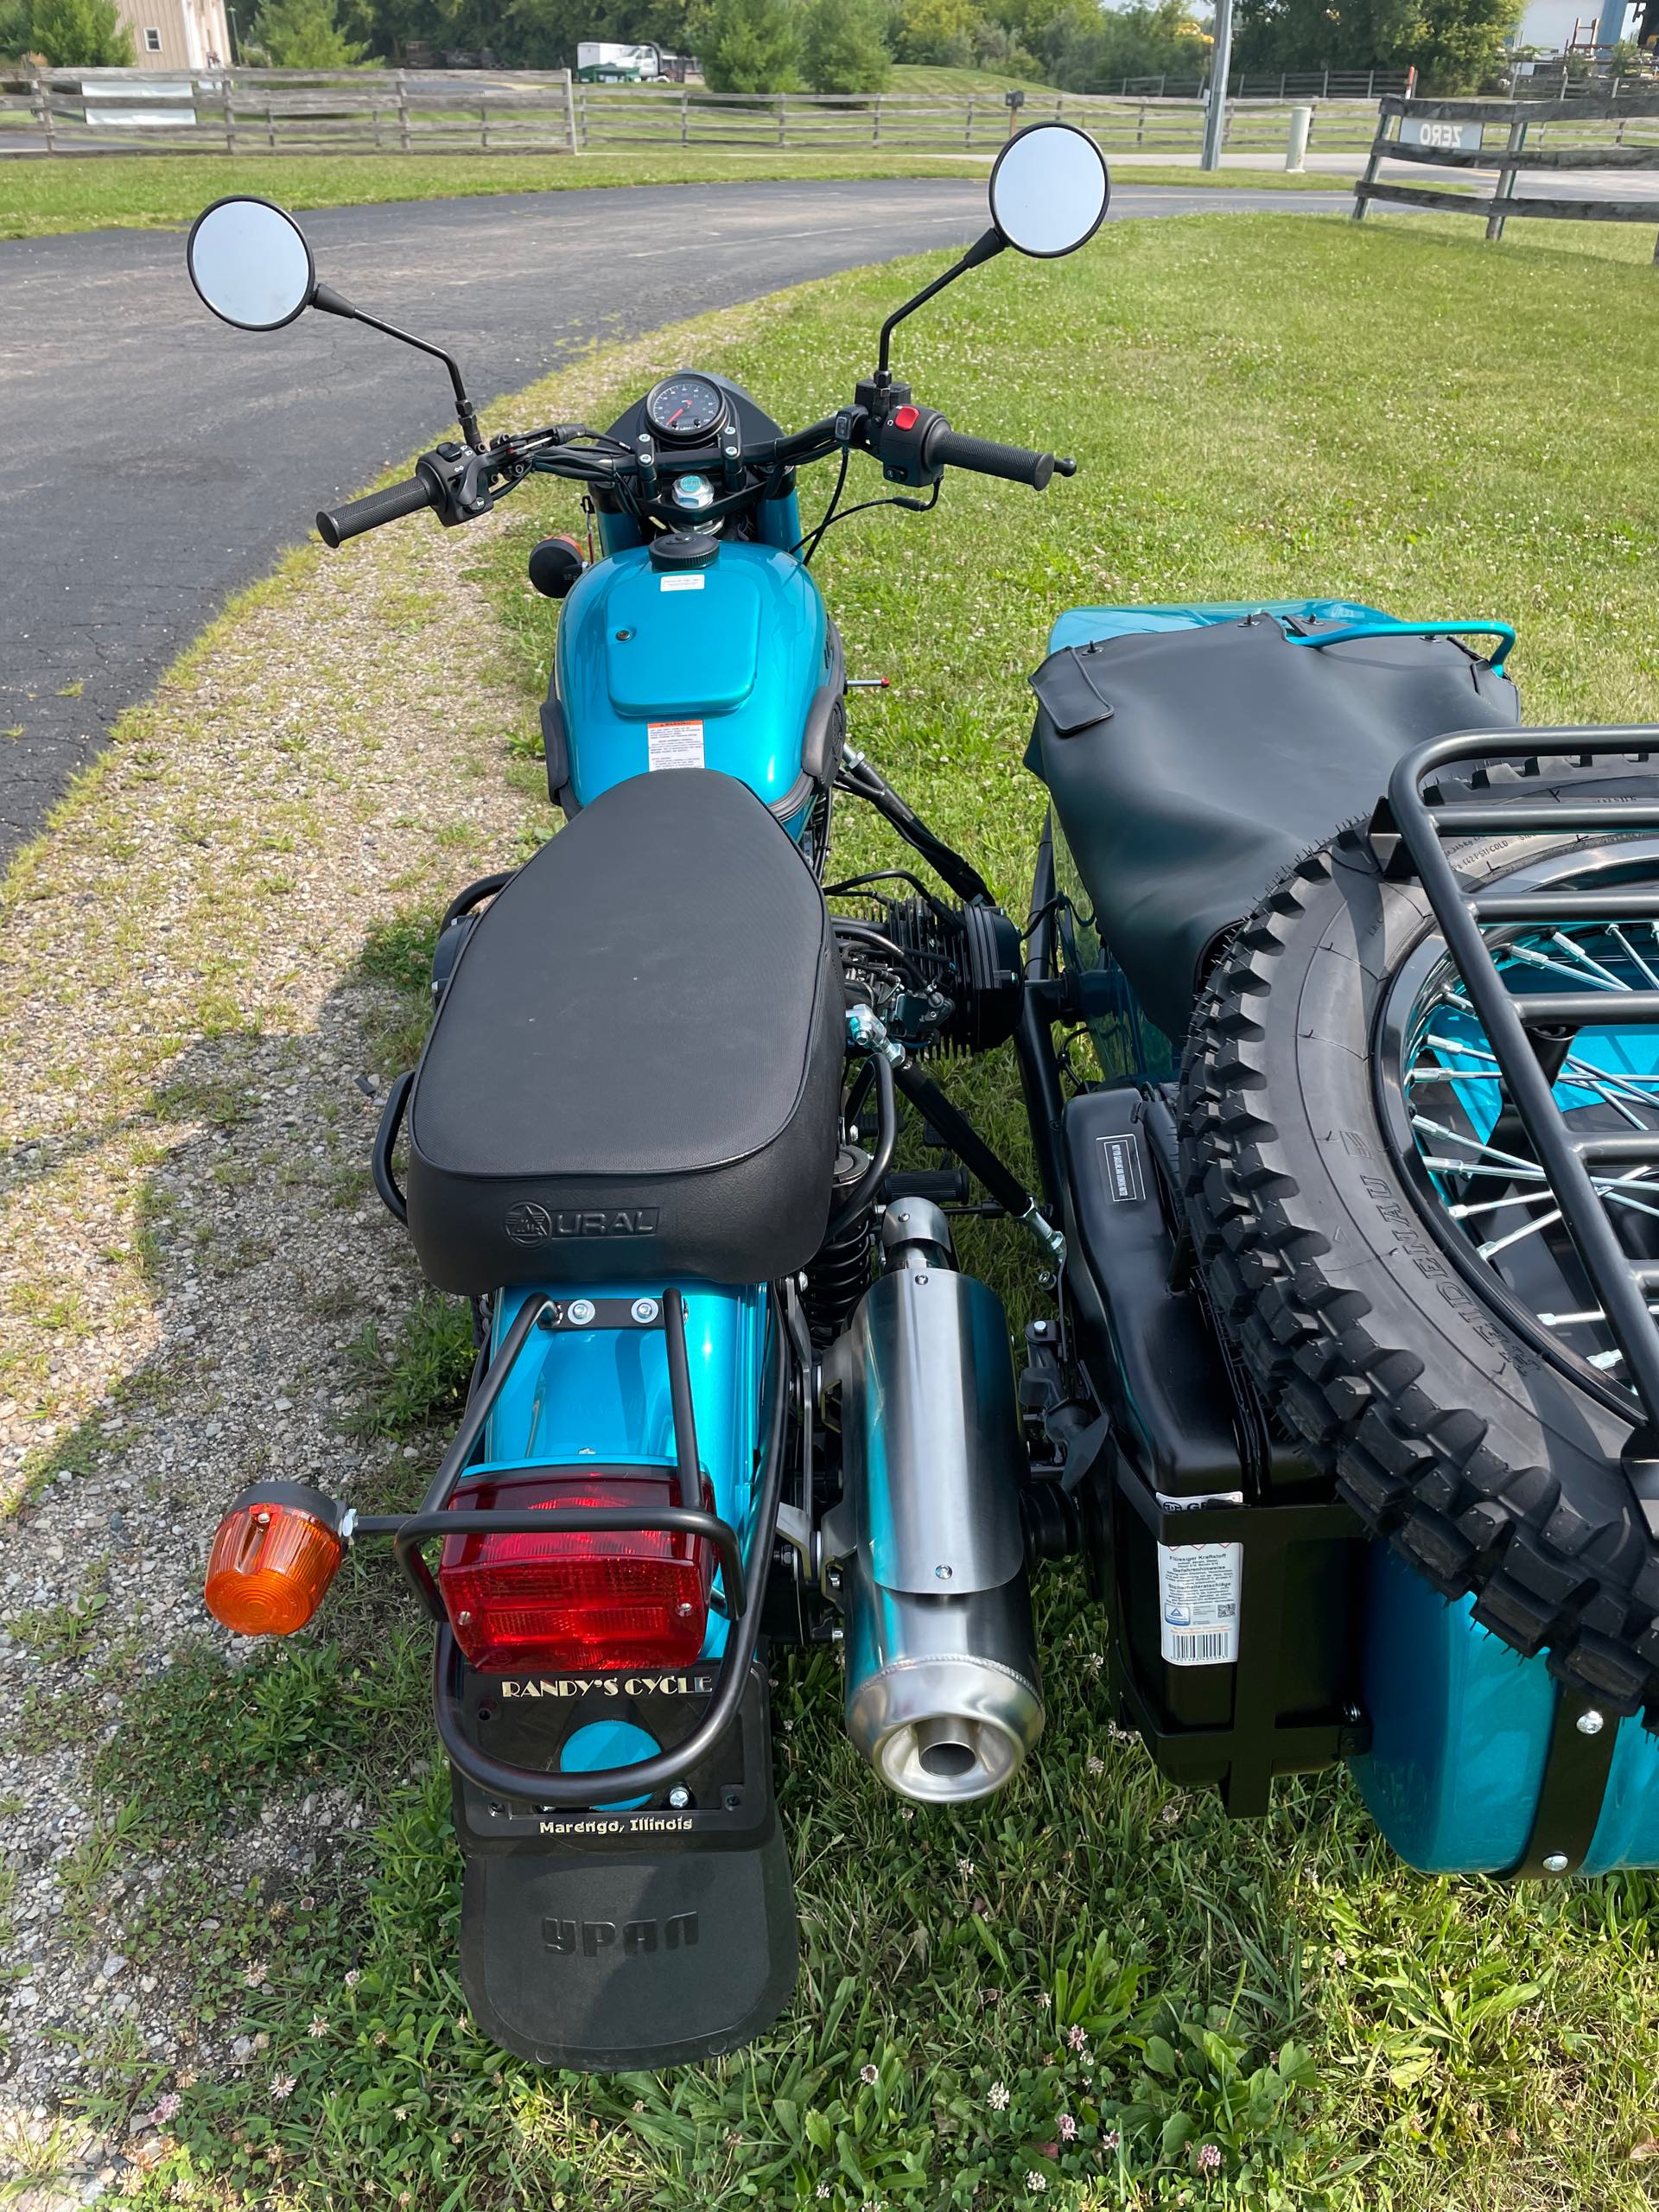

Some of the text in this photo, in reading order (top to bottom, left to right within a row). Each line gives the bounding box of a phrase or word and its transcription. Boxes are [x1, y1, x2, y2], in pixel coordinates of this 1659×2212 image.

[1490, 840, 1509, 853] COLD
[557, 1211, 653, 1236] URAL
[1360, 1174, 1541, 1376] HEIDENAU
[501, 1675, 713, 1697] RANDY'S CYCLE
[539, 1816, 693, 1834] Marengo, Illinois
